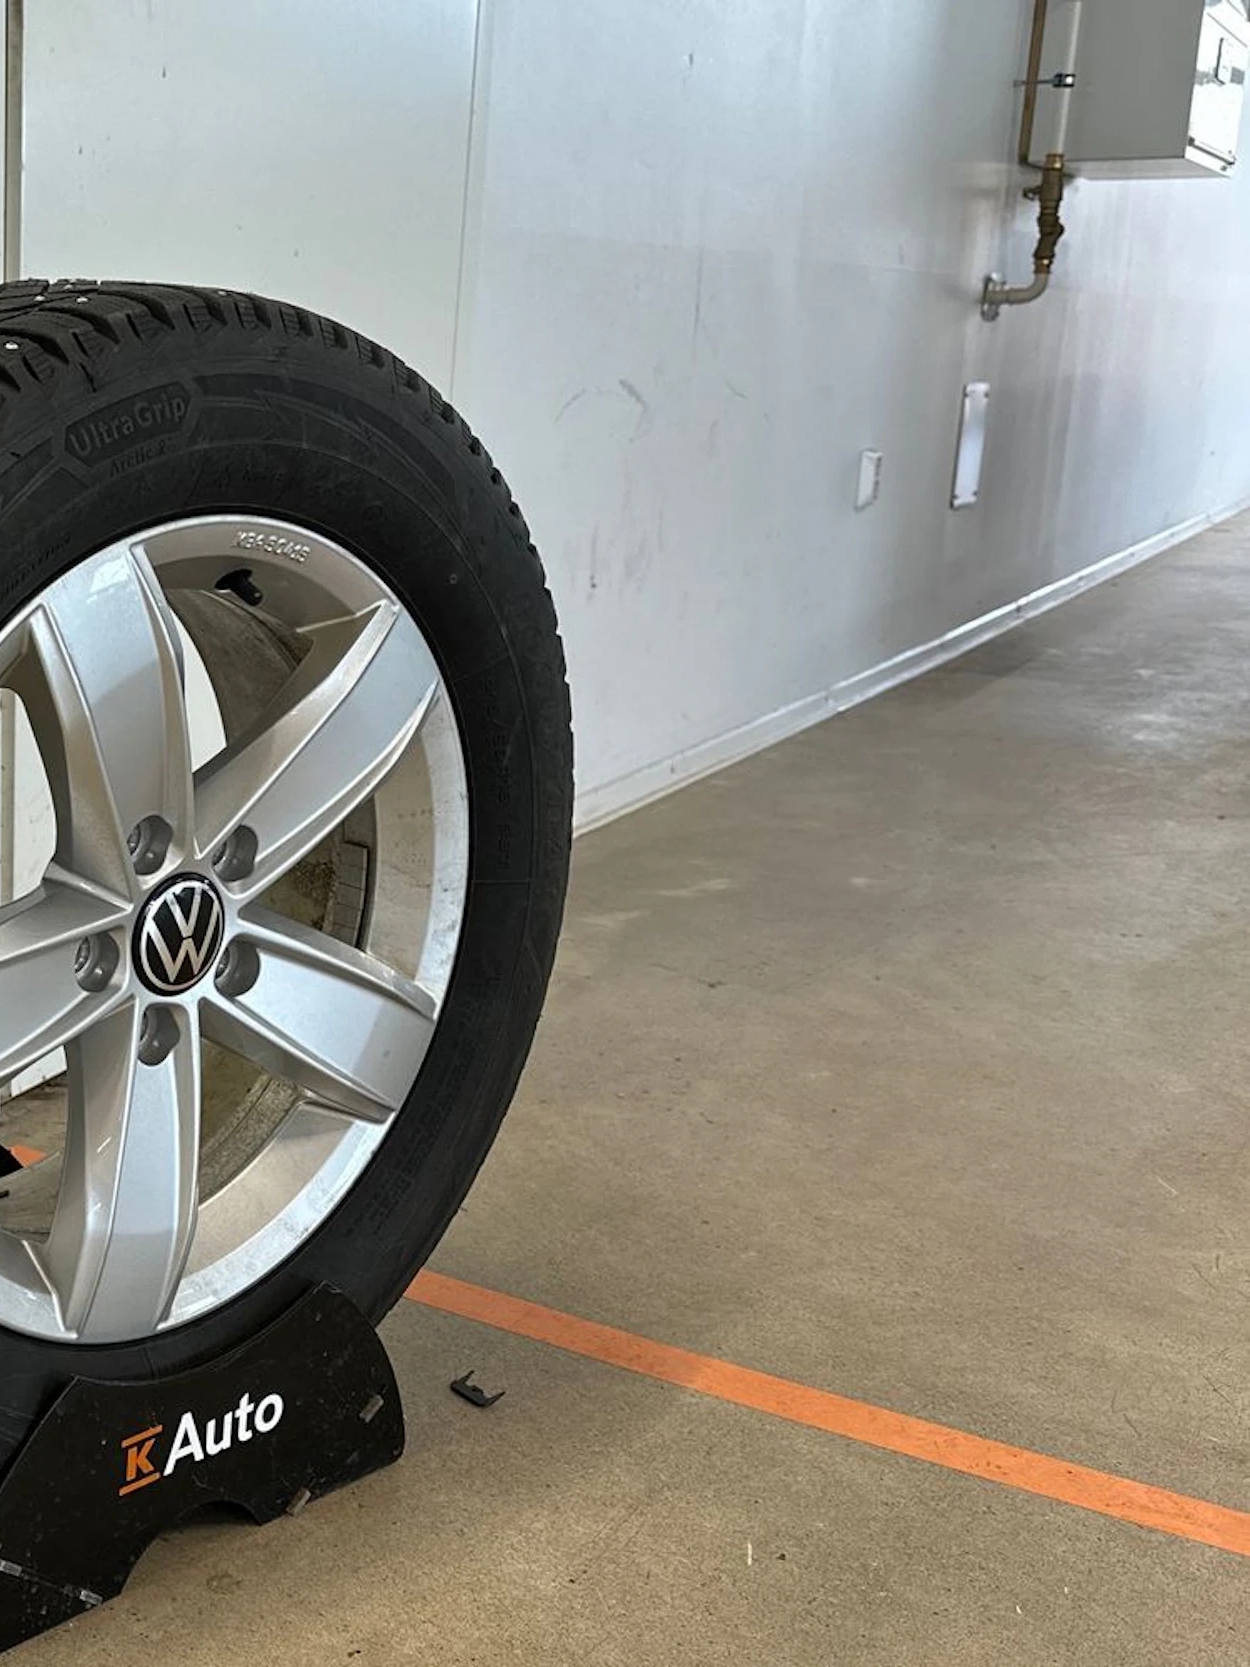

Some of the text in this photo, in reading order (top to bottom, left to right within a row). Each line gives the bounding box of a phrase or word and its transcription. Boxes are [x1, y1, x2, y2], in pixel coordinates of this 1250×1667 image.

[69, 390, 186, 457] UltraGrip
[141, 882, 223, 991] VW
[122, 1391, 285, 1490] K Auto
